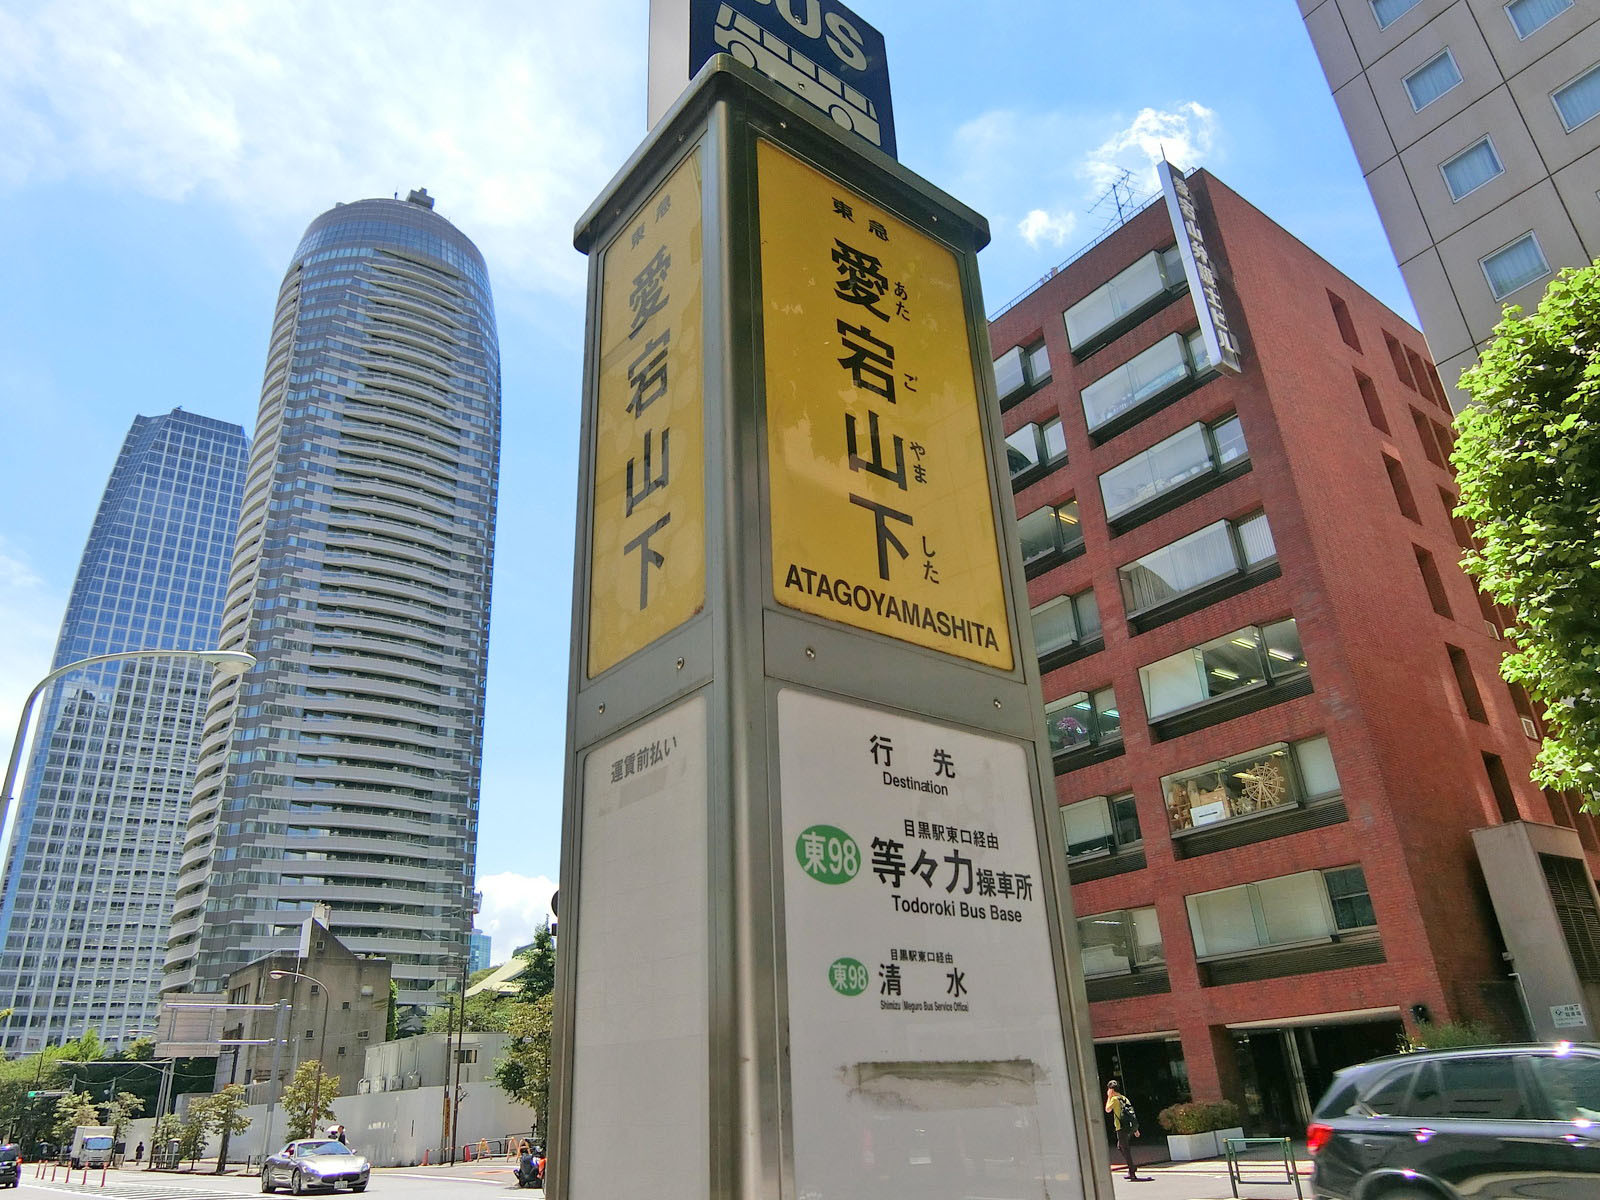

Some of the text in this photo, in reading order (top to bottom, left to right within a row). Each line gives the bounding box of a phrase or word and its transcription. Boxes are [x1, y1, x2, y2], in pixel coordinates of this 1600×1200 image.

[756, 0, 868, 71] US
[832, 197, 889, 242] 東急
[894, 281, 911, 322] あた
[623, 245, 671, 610] 愛宕山下
[831, 237, 914, 580] 愛宕山下
[910, 441, 928, 485] やま
[922, 535, 941, 585] した
[785, 563, 1000, 652] ATAGOYAMASHITA
[610, 736, 677, 784] 運賃前払い
[869, 734, 956, 778] 行先
[883, 771, 949, 796] Destination
[801, 831, 858, 877] 東98
[904, 819, 999, 850] 目黒駅東口経由
[891, 895, 1022, 923] Todoroki Bus Base
[832, 962, 868, 991] 東98
[890, 948, 954, 964] 目黒駅東口経由
[878, 963, 967, 998] 清水
